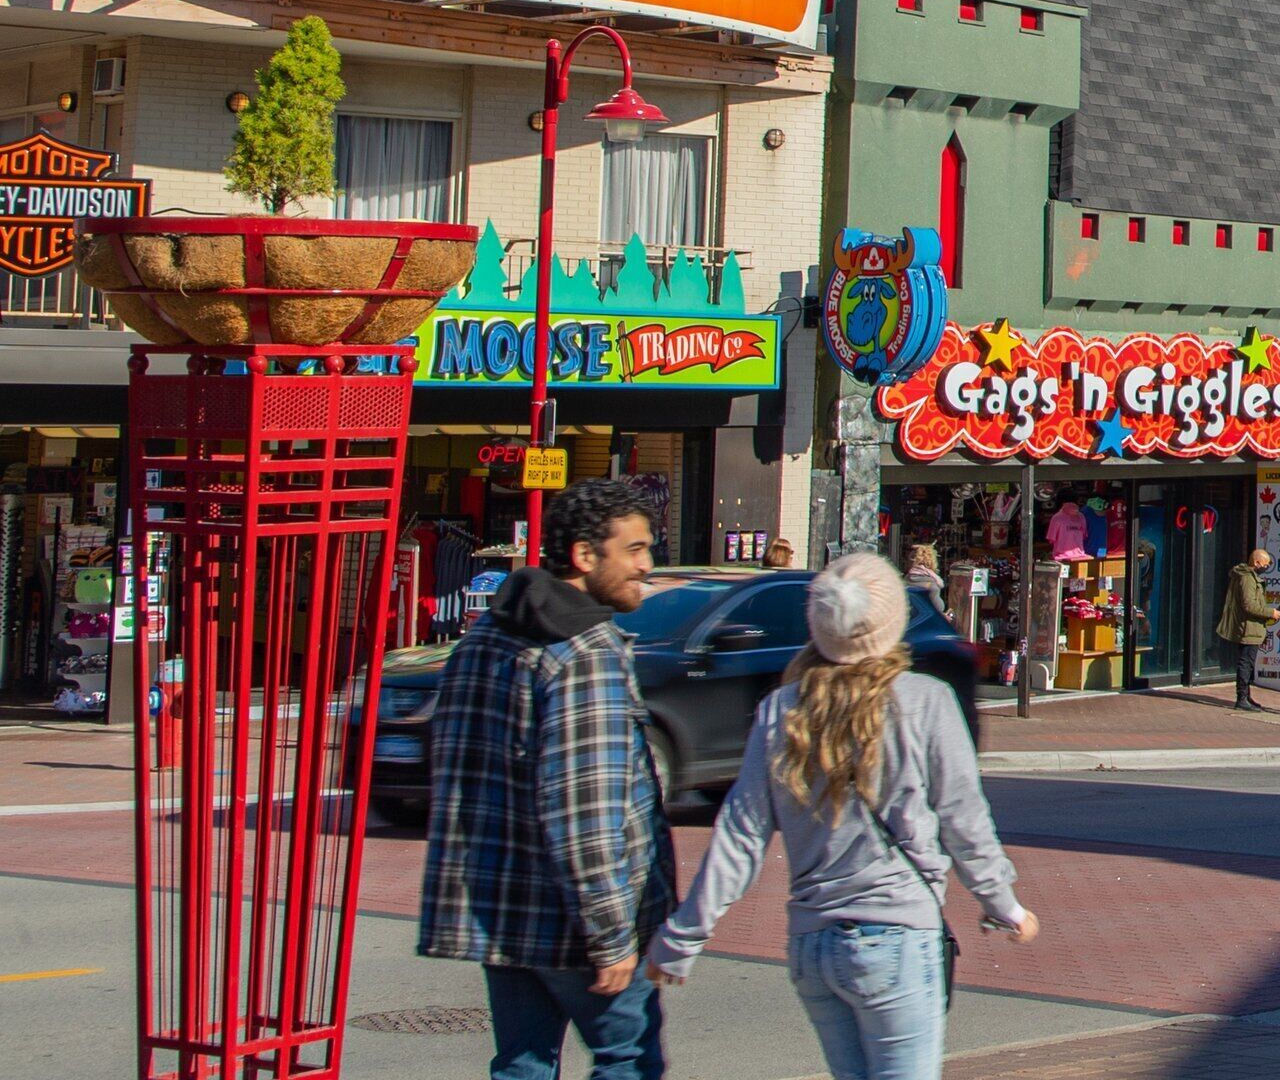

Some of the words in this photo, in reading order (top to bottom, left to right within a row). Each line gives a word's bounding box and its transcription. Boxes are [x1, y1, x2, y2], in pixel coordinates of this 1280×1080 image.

[828, 270, 847, 312] BLUE
[638, 331, 721, 367] TRADING
[828, 316, 856, 364] MOOSE
[888, 304, 911, 354] Trading
[943, 361, 1058, 440] Gags
[1069, 363, 1107, 412] 'n
[478, 445, 525, 463] OPEN
